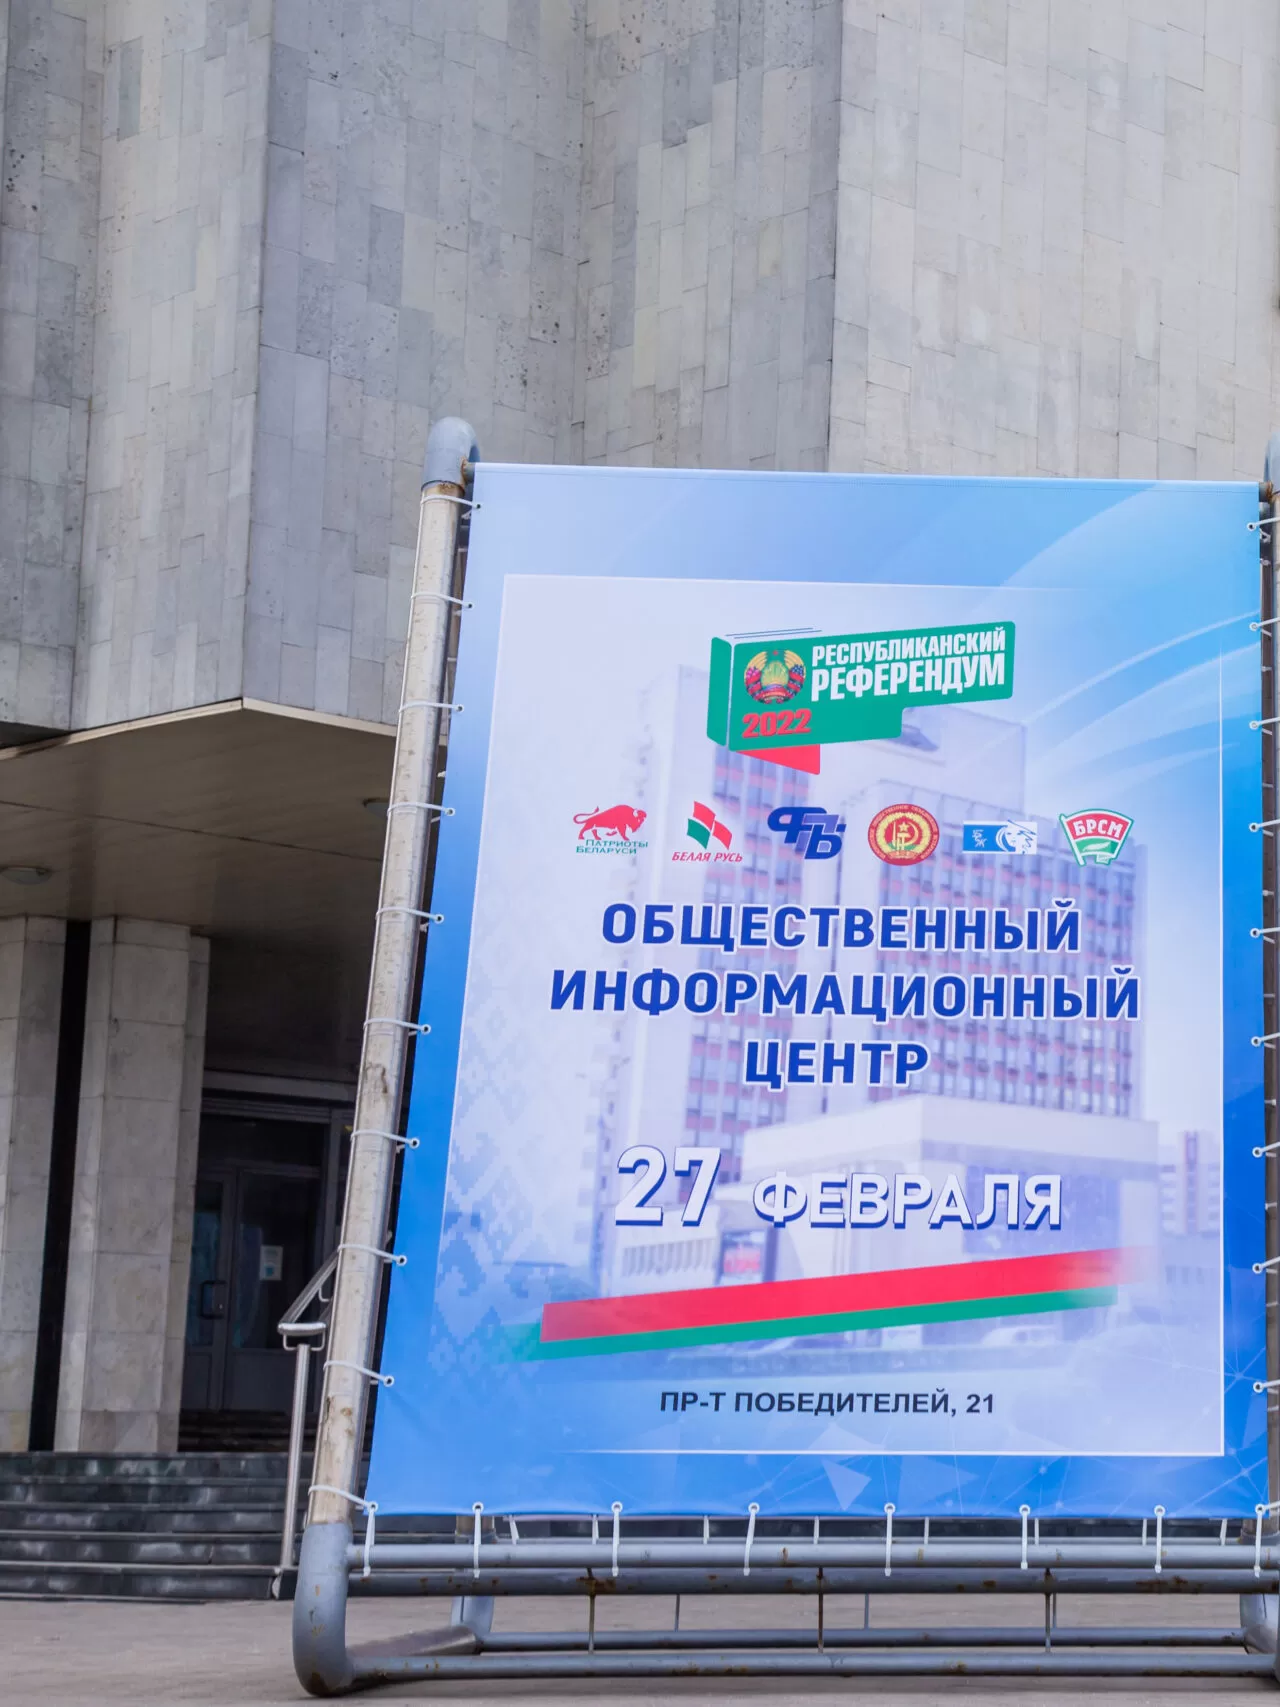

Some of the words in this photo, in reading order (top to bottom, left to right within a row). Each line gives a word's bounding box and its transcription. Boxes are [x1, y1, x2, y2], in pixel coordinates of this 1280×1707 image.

[811, 627, 1006, 667] РЕСПУБЛИКАНСКИЙ
[811, 653, 1005, 702] РЕФЕРЕНДУМ
[742, 709, 812, 738] 2022
[1073, 818, 1123, 838] БРСМ
[671, 851, 711, 862] БЕЛАЯ
[713, 852, 743, 862] РУСЬ
[602, 898, 1080, 953] ОБЩЕСТВЕННЫЙ
[549, 965, 1140, 1022] ИНФОРМАЦИОННЫЙ
[744, 1040, 929, 1087] ЦЕНТР
[615, 1145, 721, 1227] 27
[753, 1170, 1063, 1230] ФЕВРАЛЯ
[660, 1391, 726, 1413] ПР-Т
[734, 1387, 957, 1417] ПОБЕДИТЕЛЕЙ,
[966, 1393, 995, 1414] 21
